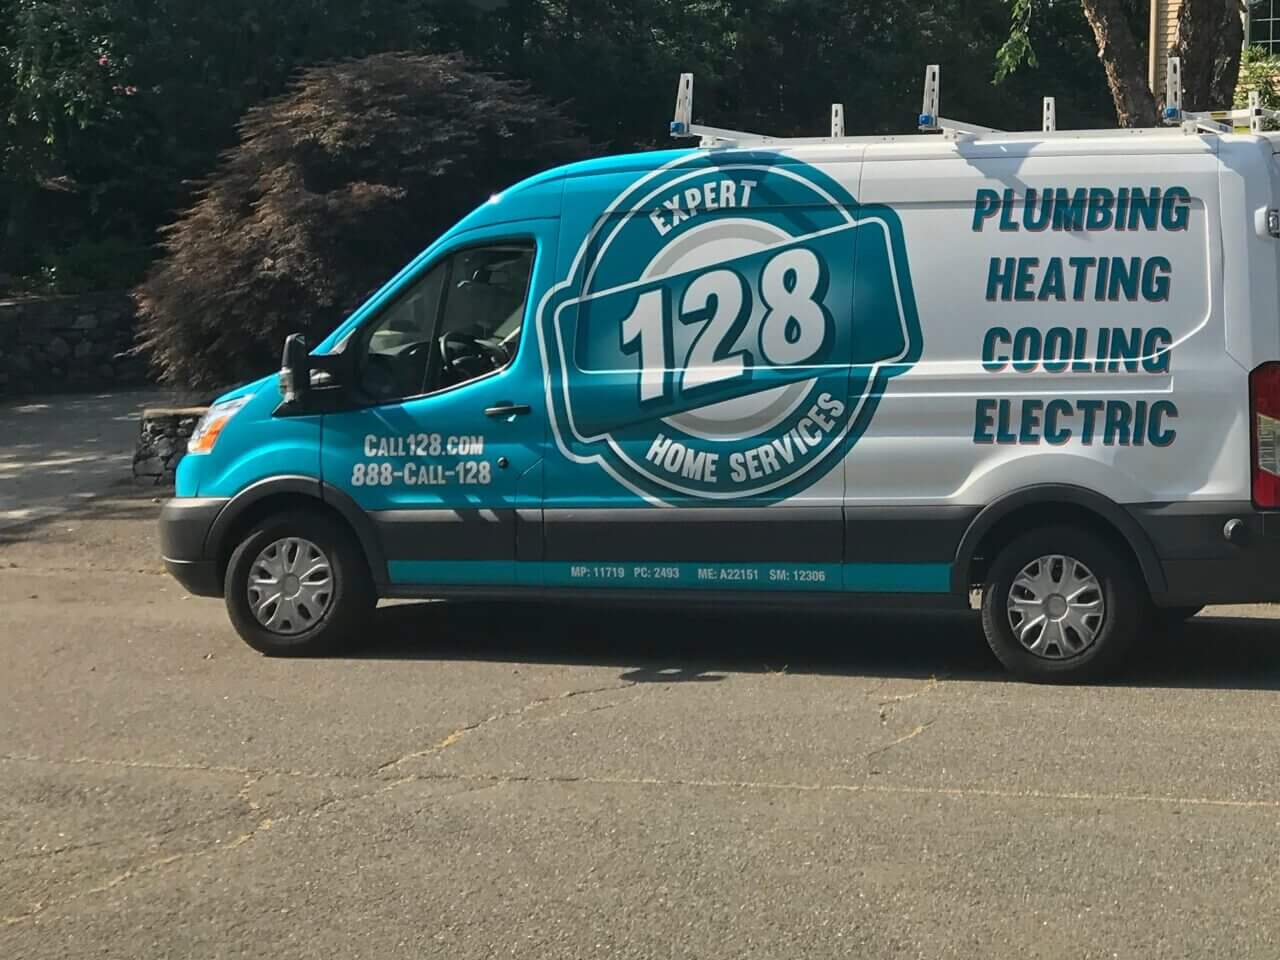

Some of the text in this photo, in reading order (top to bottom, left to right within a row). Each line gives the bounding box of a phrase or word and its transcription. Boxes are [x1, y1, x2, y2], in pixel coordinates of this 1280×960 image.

[650, 180, 757, 236] EXPERT
[972, 186, 1191, 232] PLUMBING
[985, 256, 1172, 302] HEATING
[622, 248, 826, 401] 128
[981, 326, 1173, 373] COOLING
[646, 393, 846, 482] HOME SERVICES
[973, 398, 1179, 447] ELECTRIC
[571, 566, 826, 581] MP: 11719 PC: 2493 ME: A22151 SM: 12306
